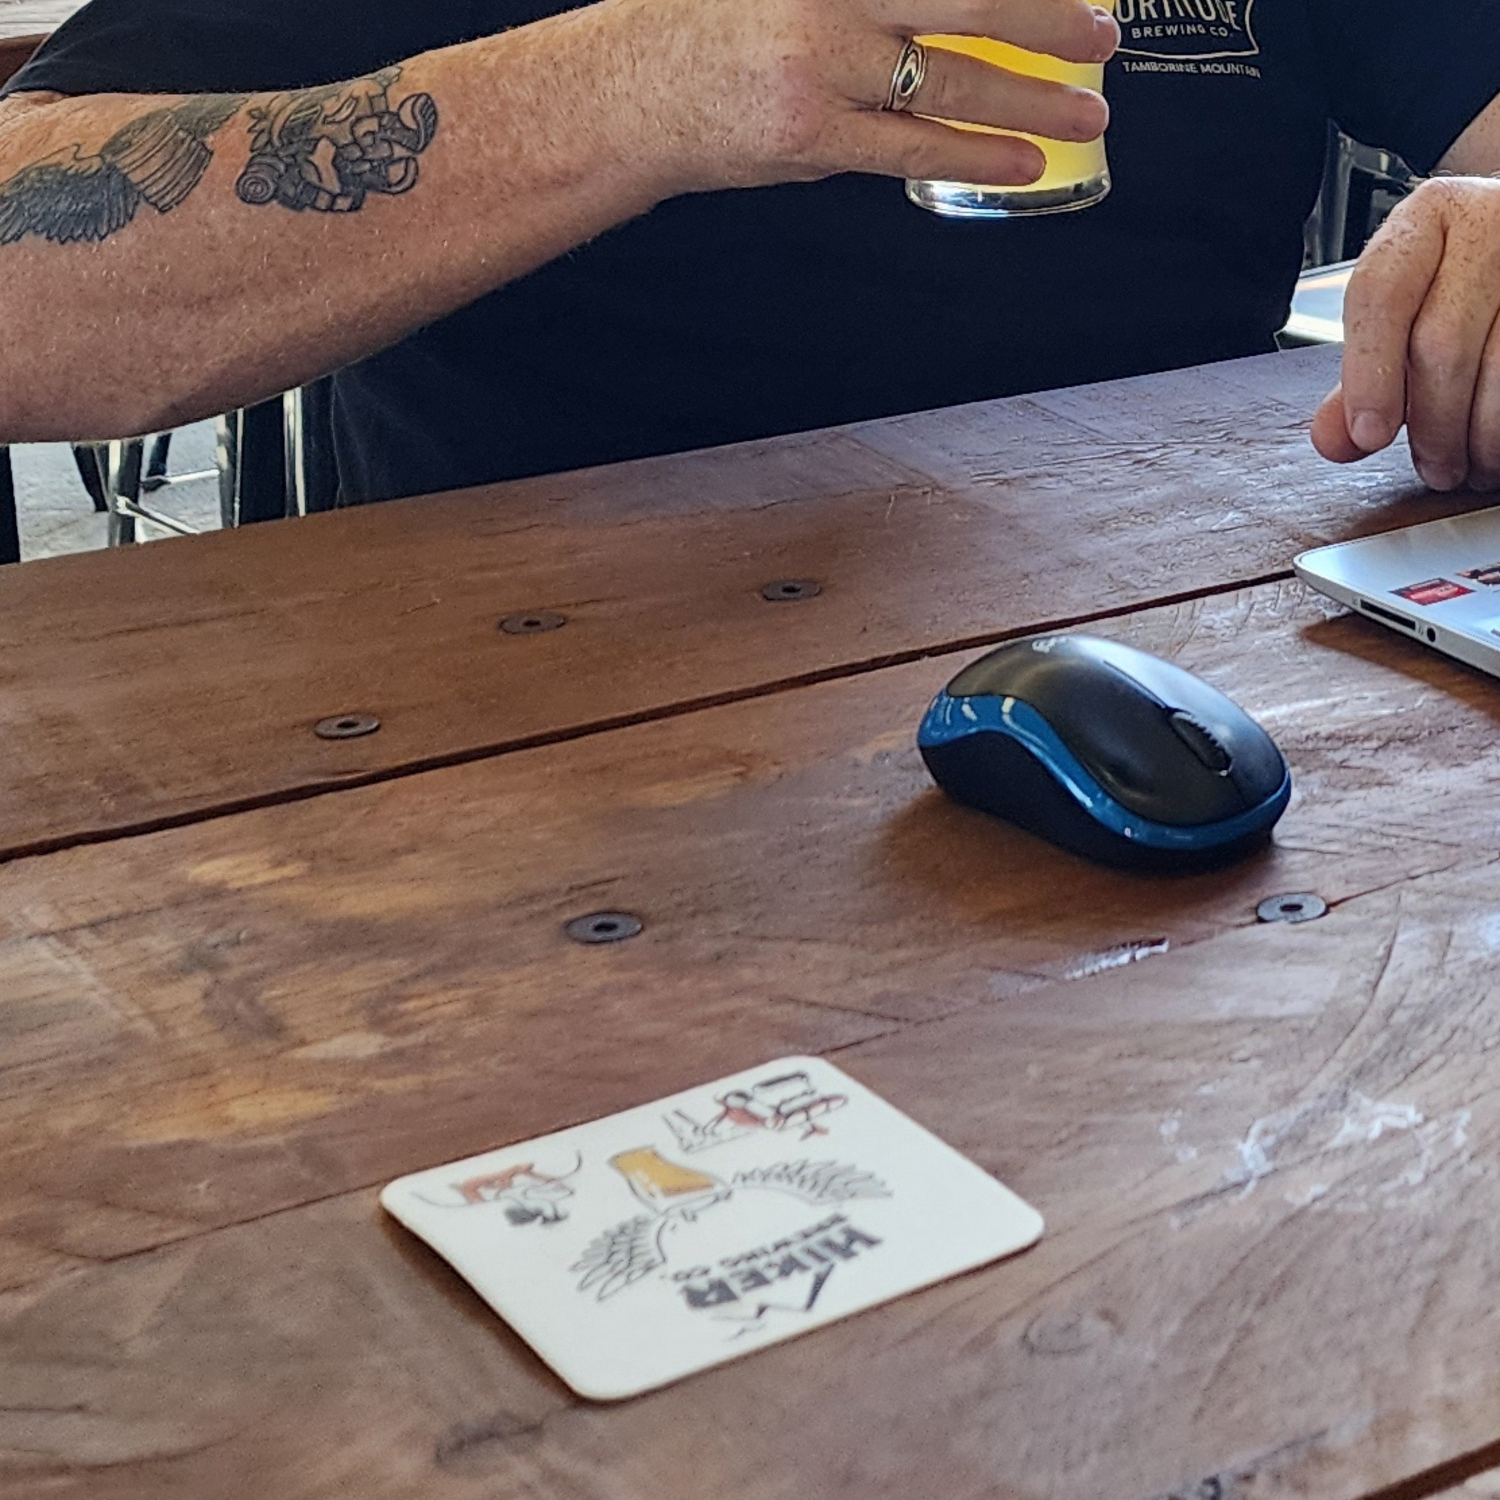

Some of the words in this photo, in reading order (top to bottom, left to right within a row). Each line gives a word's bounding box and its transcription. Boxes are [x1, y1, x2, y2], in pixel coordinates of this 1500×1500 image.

[1131, 23, 1206, 39] BREWING
[1209, 25, 1234, 38] CO.
[1122, 60, 1199, 74] TAMBORINE
[680, 1225, 884, 1309] HIKER
